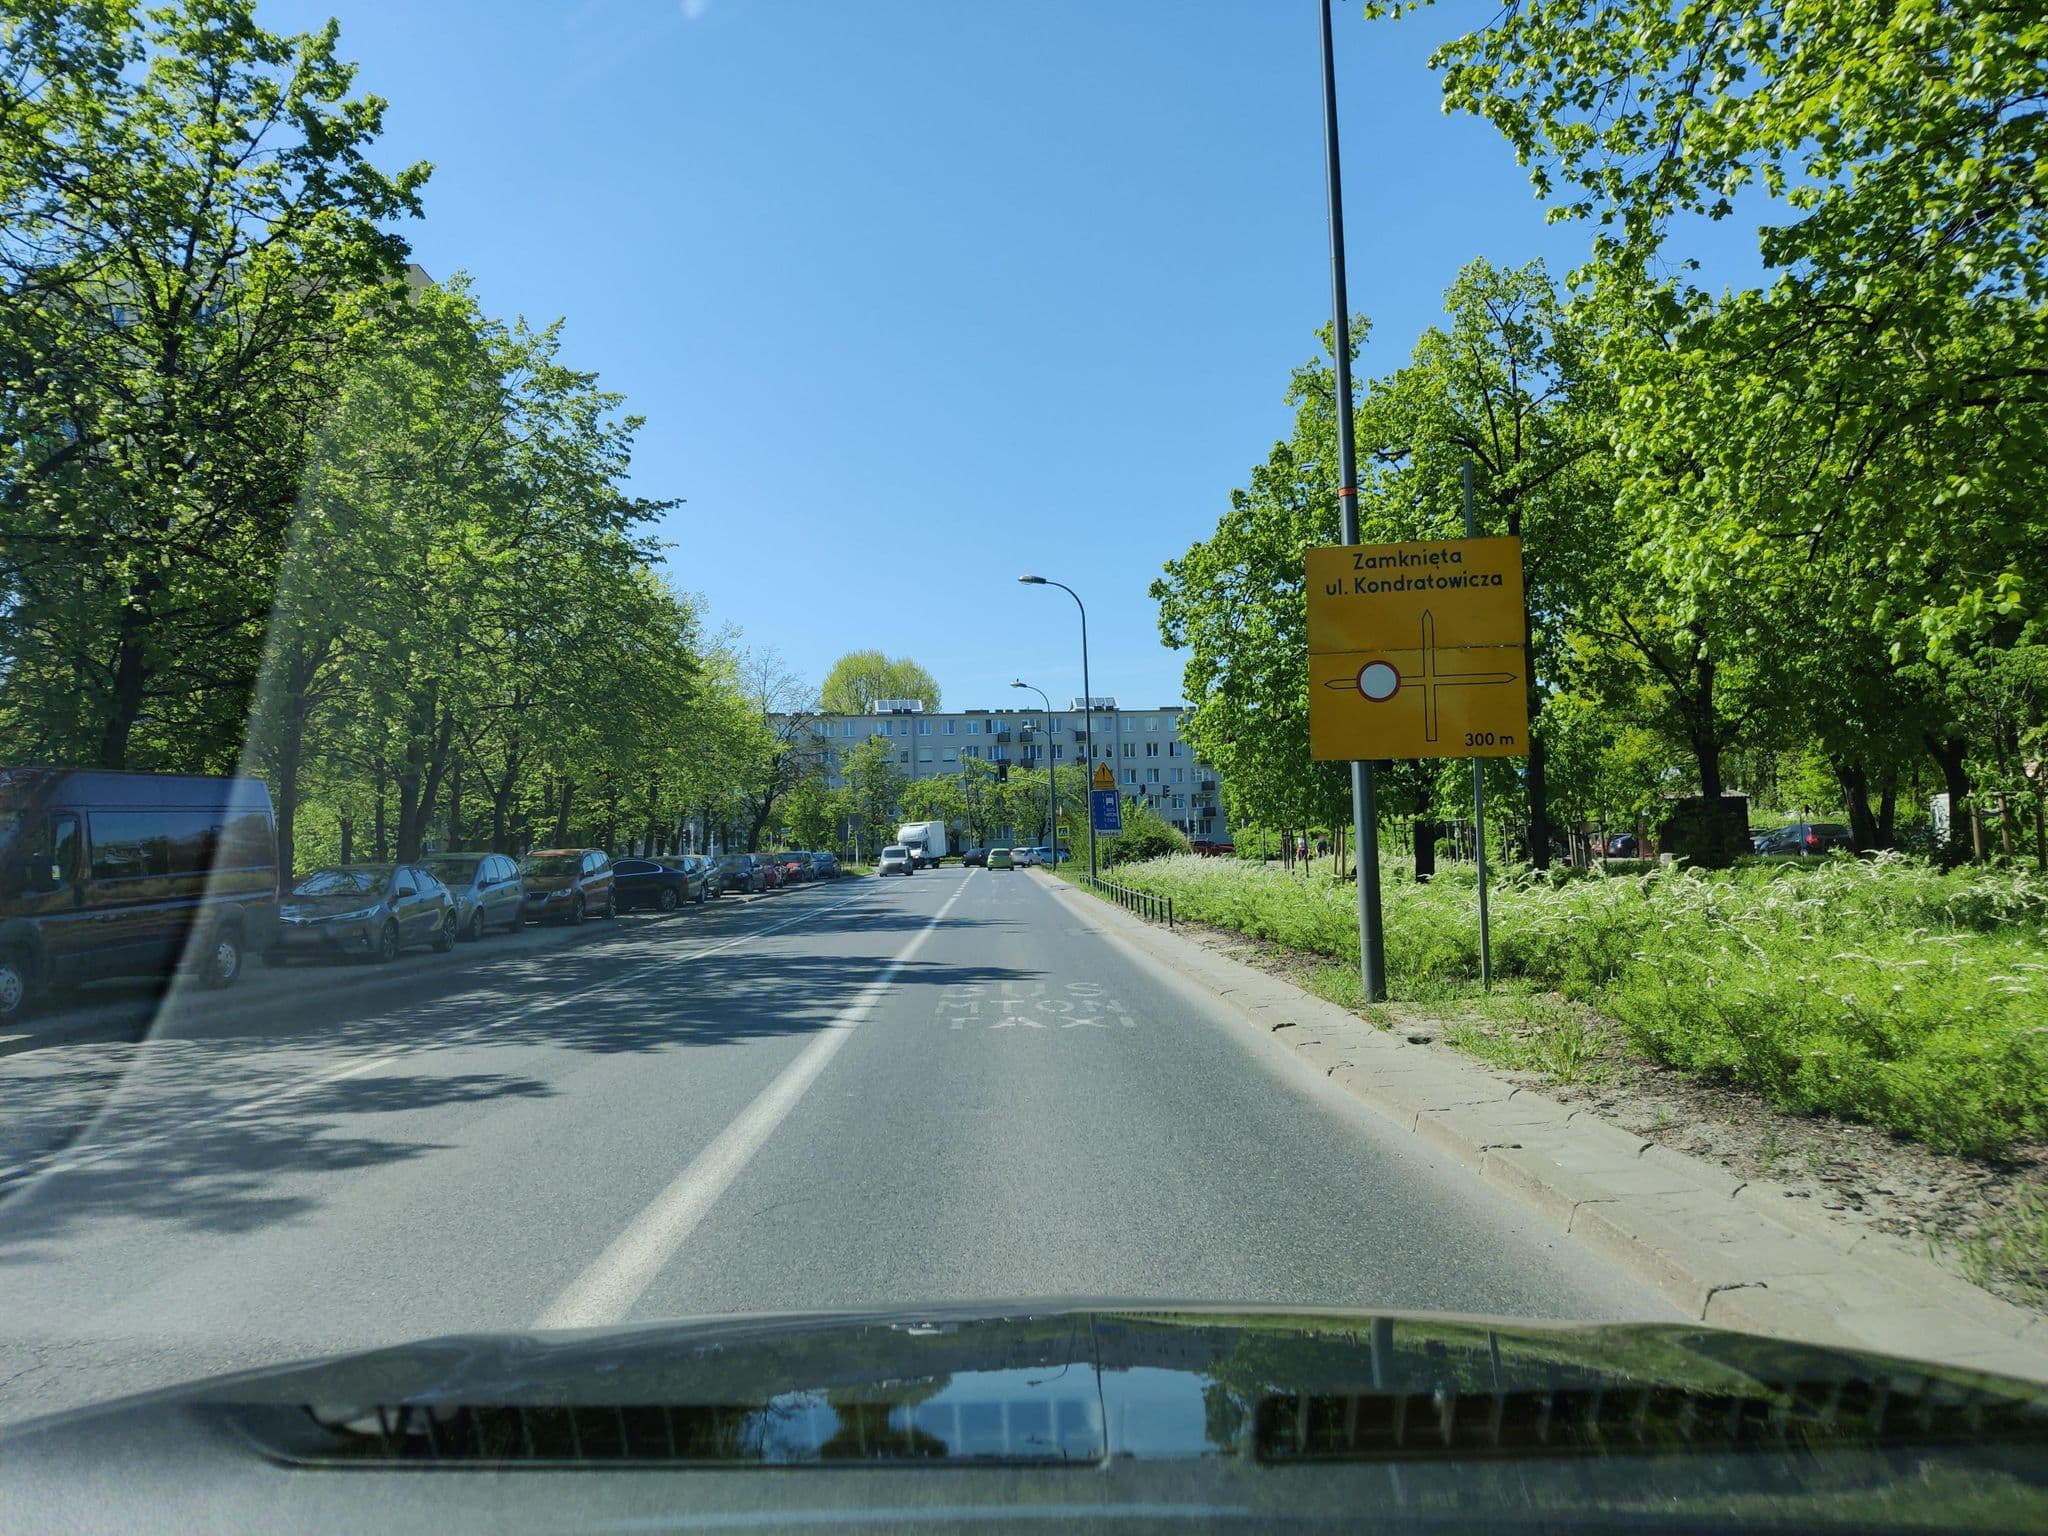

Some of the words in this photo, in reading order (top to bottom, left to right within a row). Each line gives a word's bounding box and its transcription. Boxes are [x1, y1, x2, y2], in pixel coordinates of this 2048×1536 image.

[1352, 549, 1463, 570] Zamknięta
[1325, 578, 1348, 596] ul.
[1354, 571, 1503, 594] Kondratowicza
[1464, 732, 1495, 747] 300
[1499, 735, 1514, 745] m
